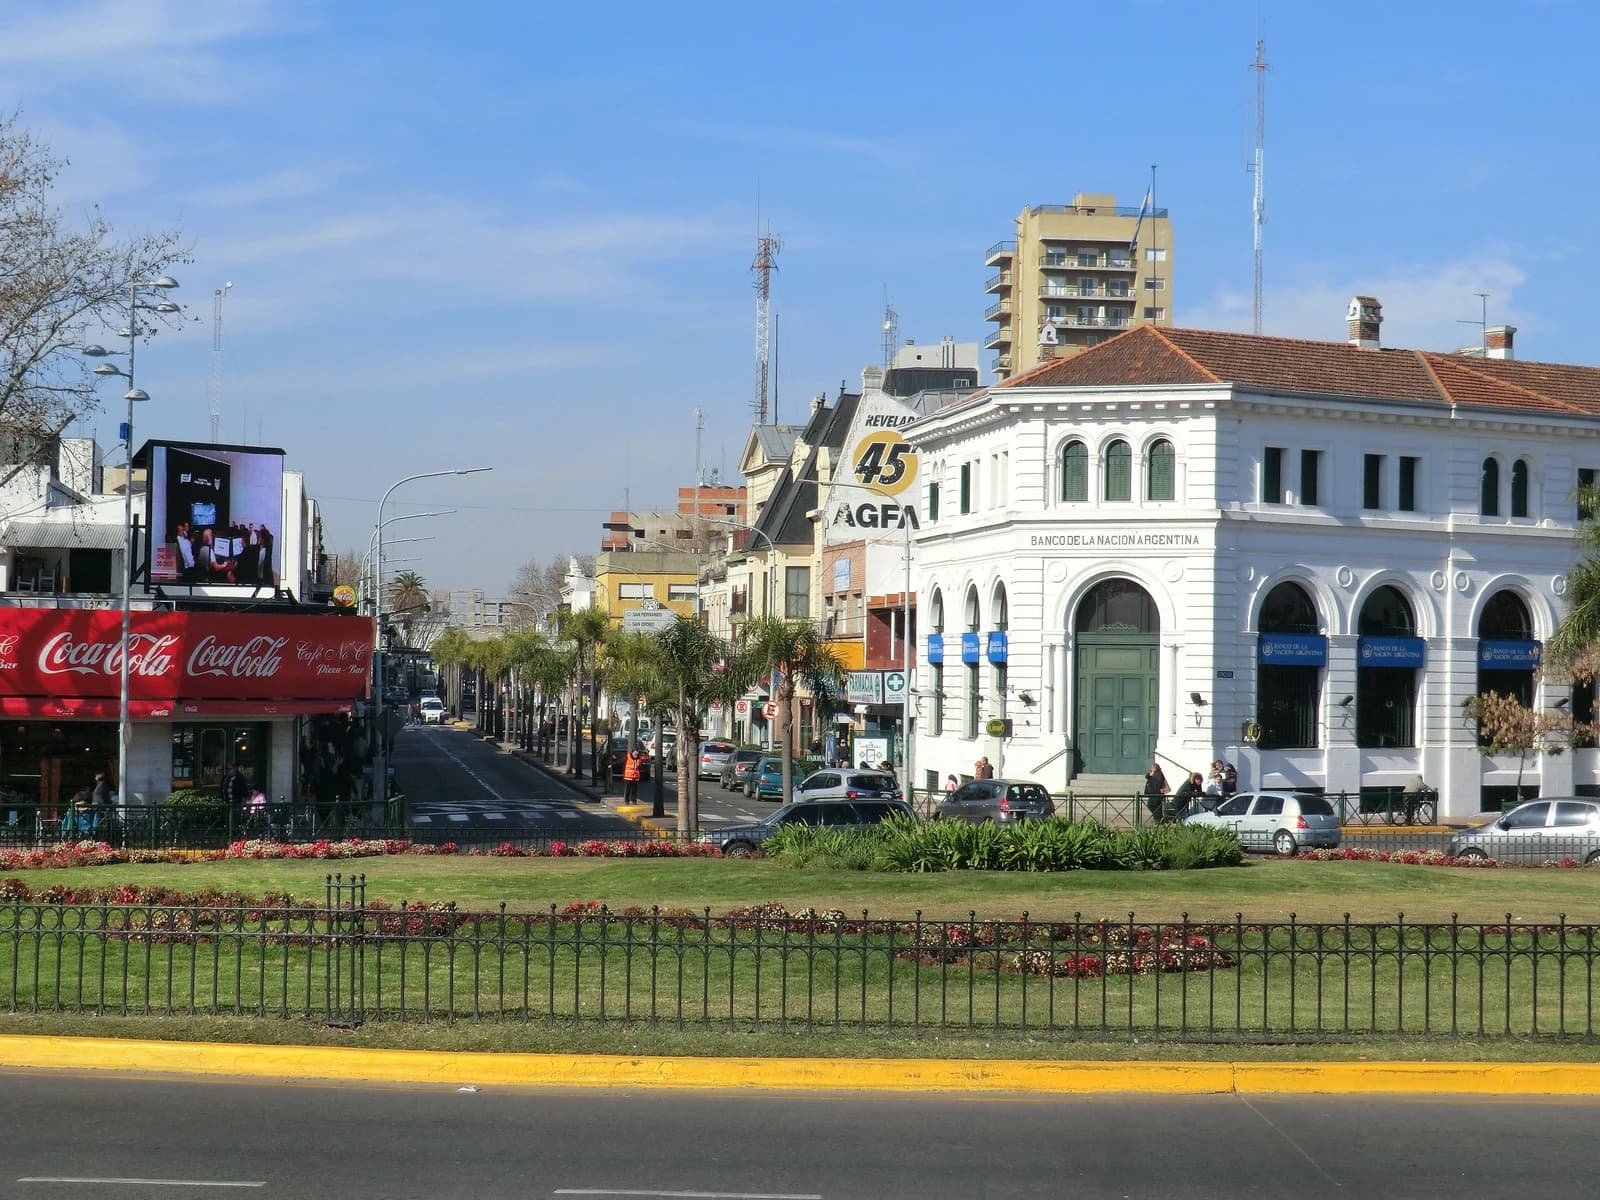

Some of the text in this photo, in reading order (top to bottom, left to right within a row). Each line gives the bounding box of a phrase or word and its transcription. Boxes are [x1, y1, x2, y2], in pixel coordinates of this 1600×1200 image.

[865, 414, 922, 427] REVELAD
[832, 503, 920, 529] AGFA
[1031, 534, 1200, 546] BANCO DE LA NACION ARGENTINA
[38, 631, 180, 677] Coca-Cola
[186, 634, 290, 677] Coca-Cola
[296, 640, 324, 666] Café
[315, 663, 342, 676] Pizza
[348, 664, 365, 674] Bar
